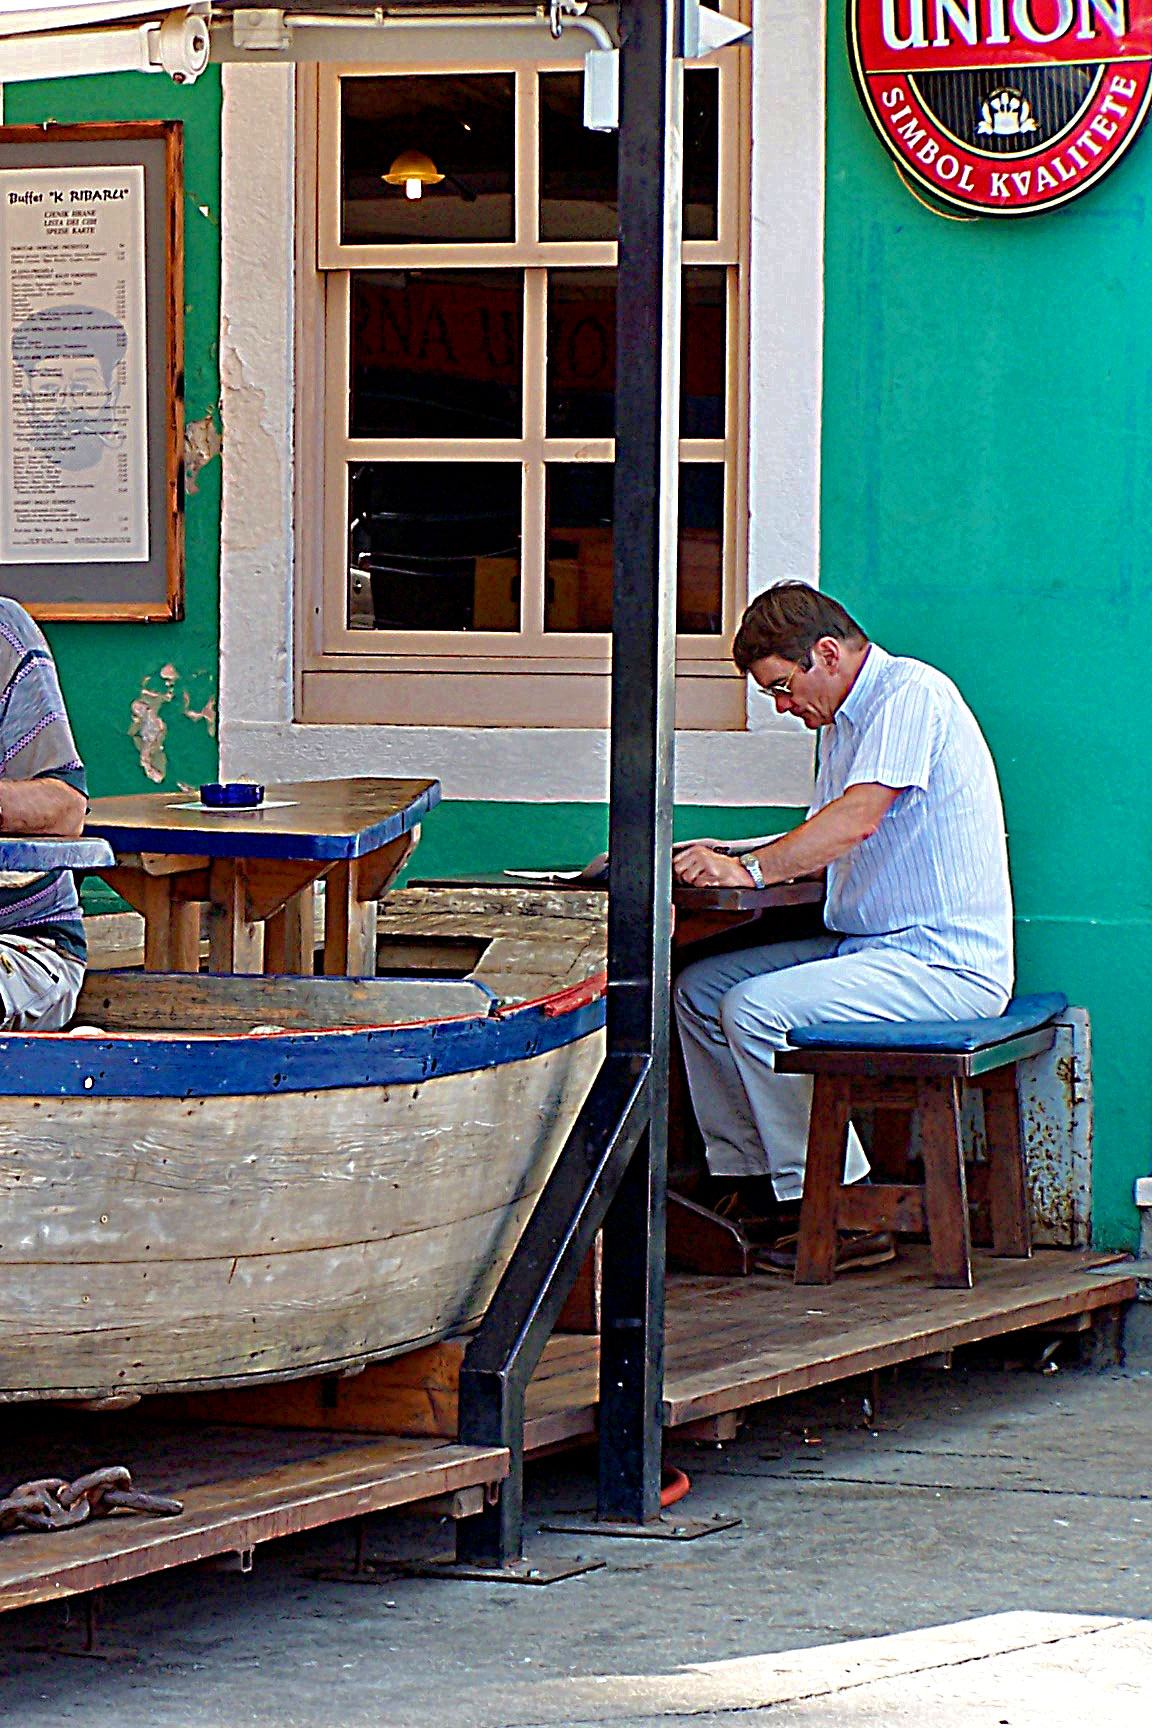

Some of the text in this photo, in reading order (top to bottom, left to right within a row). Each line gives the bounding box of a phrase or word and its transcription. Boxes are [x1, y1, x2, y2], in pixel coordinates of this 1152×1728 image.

[882, 0, 1127, 50] UNION
[882, 75, 1137, 198] SIMBOL KVALITETE
[8, 191, 43, 204] Buffet
